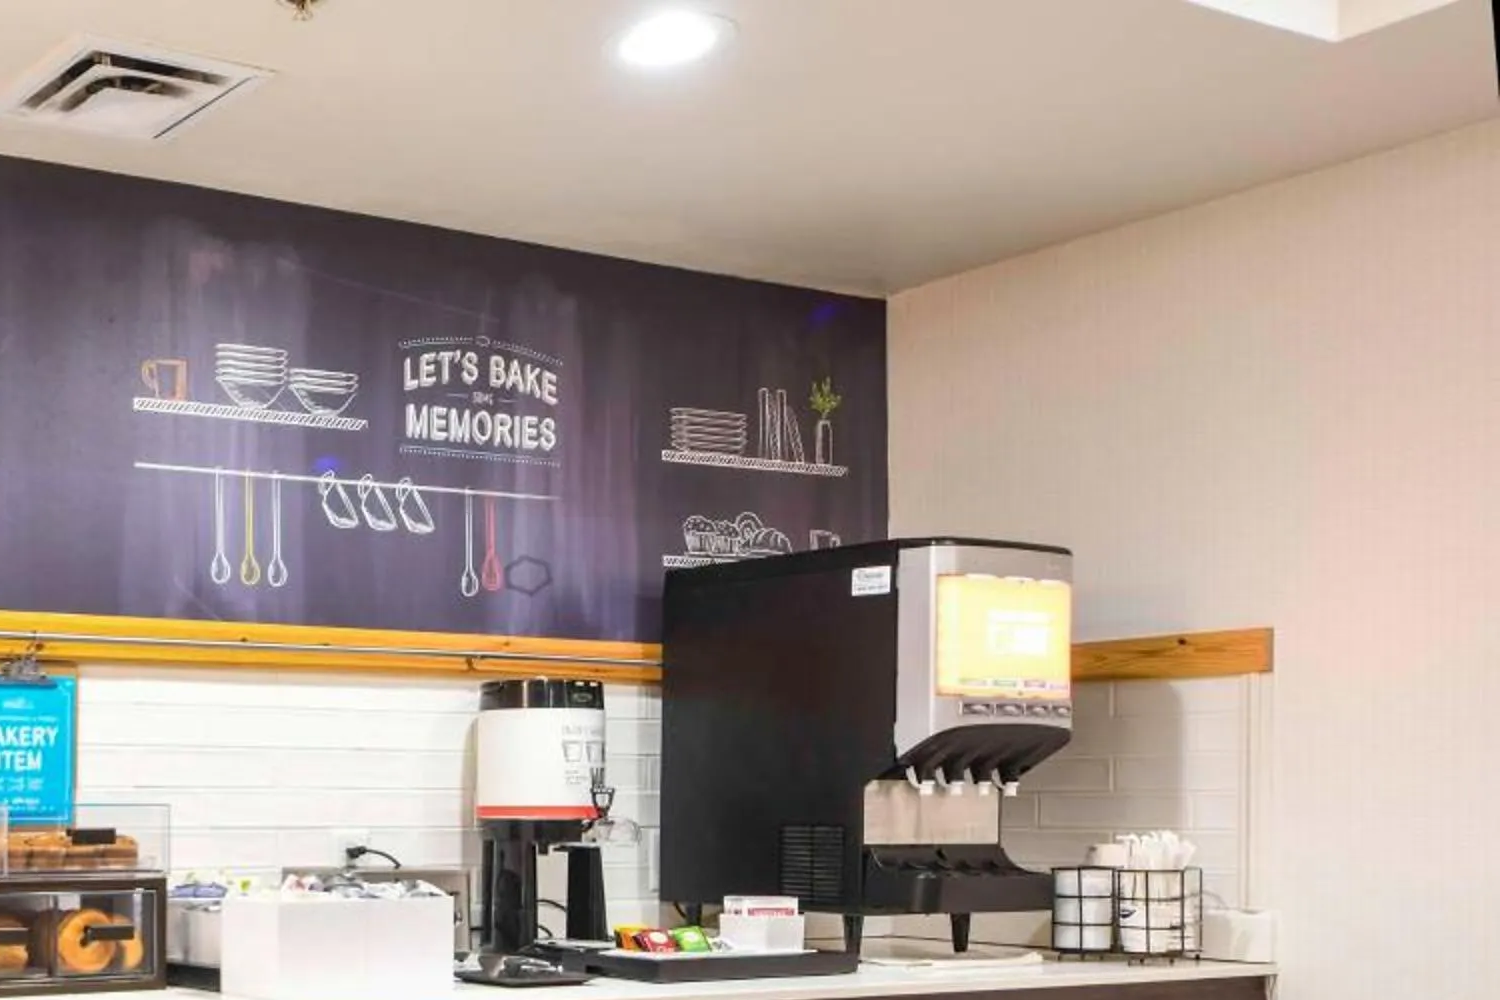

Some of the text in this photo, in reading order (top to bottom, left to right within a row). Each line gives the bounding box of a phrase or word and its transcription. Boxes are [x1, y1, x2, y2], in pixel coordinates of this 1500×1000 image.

[403, 350, 559, 406] LET'S BAKE
[405, 403, 556, 451] MEMORIES
